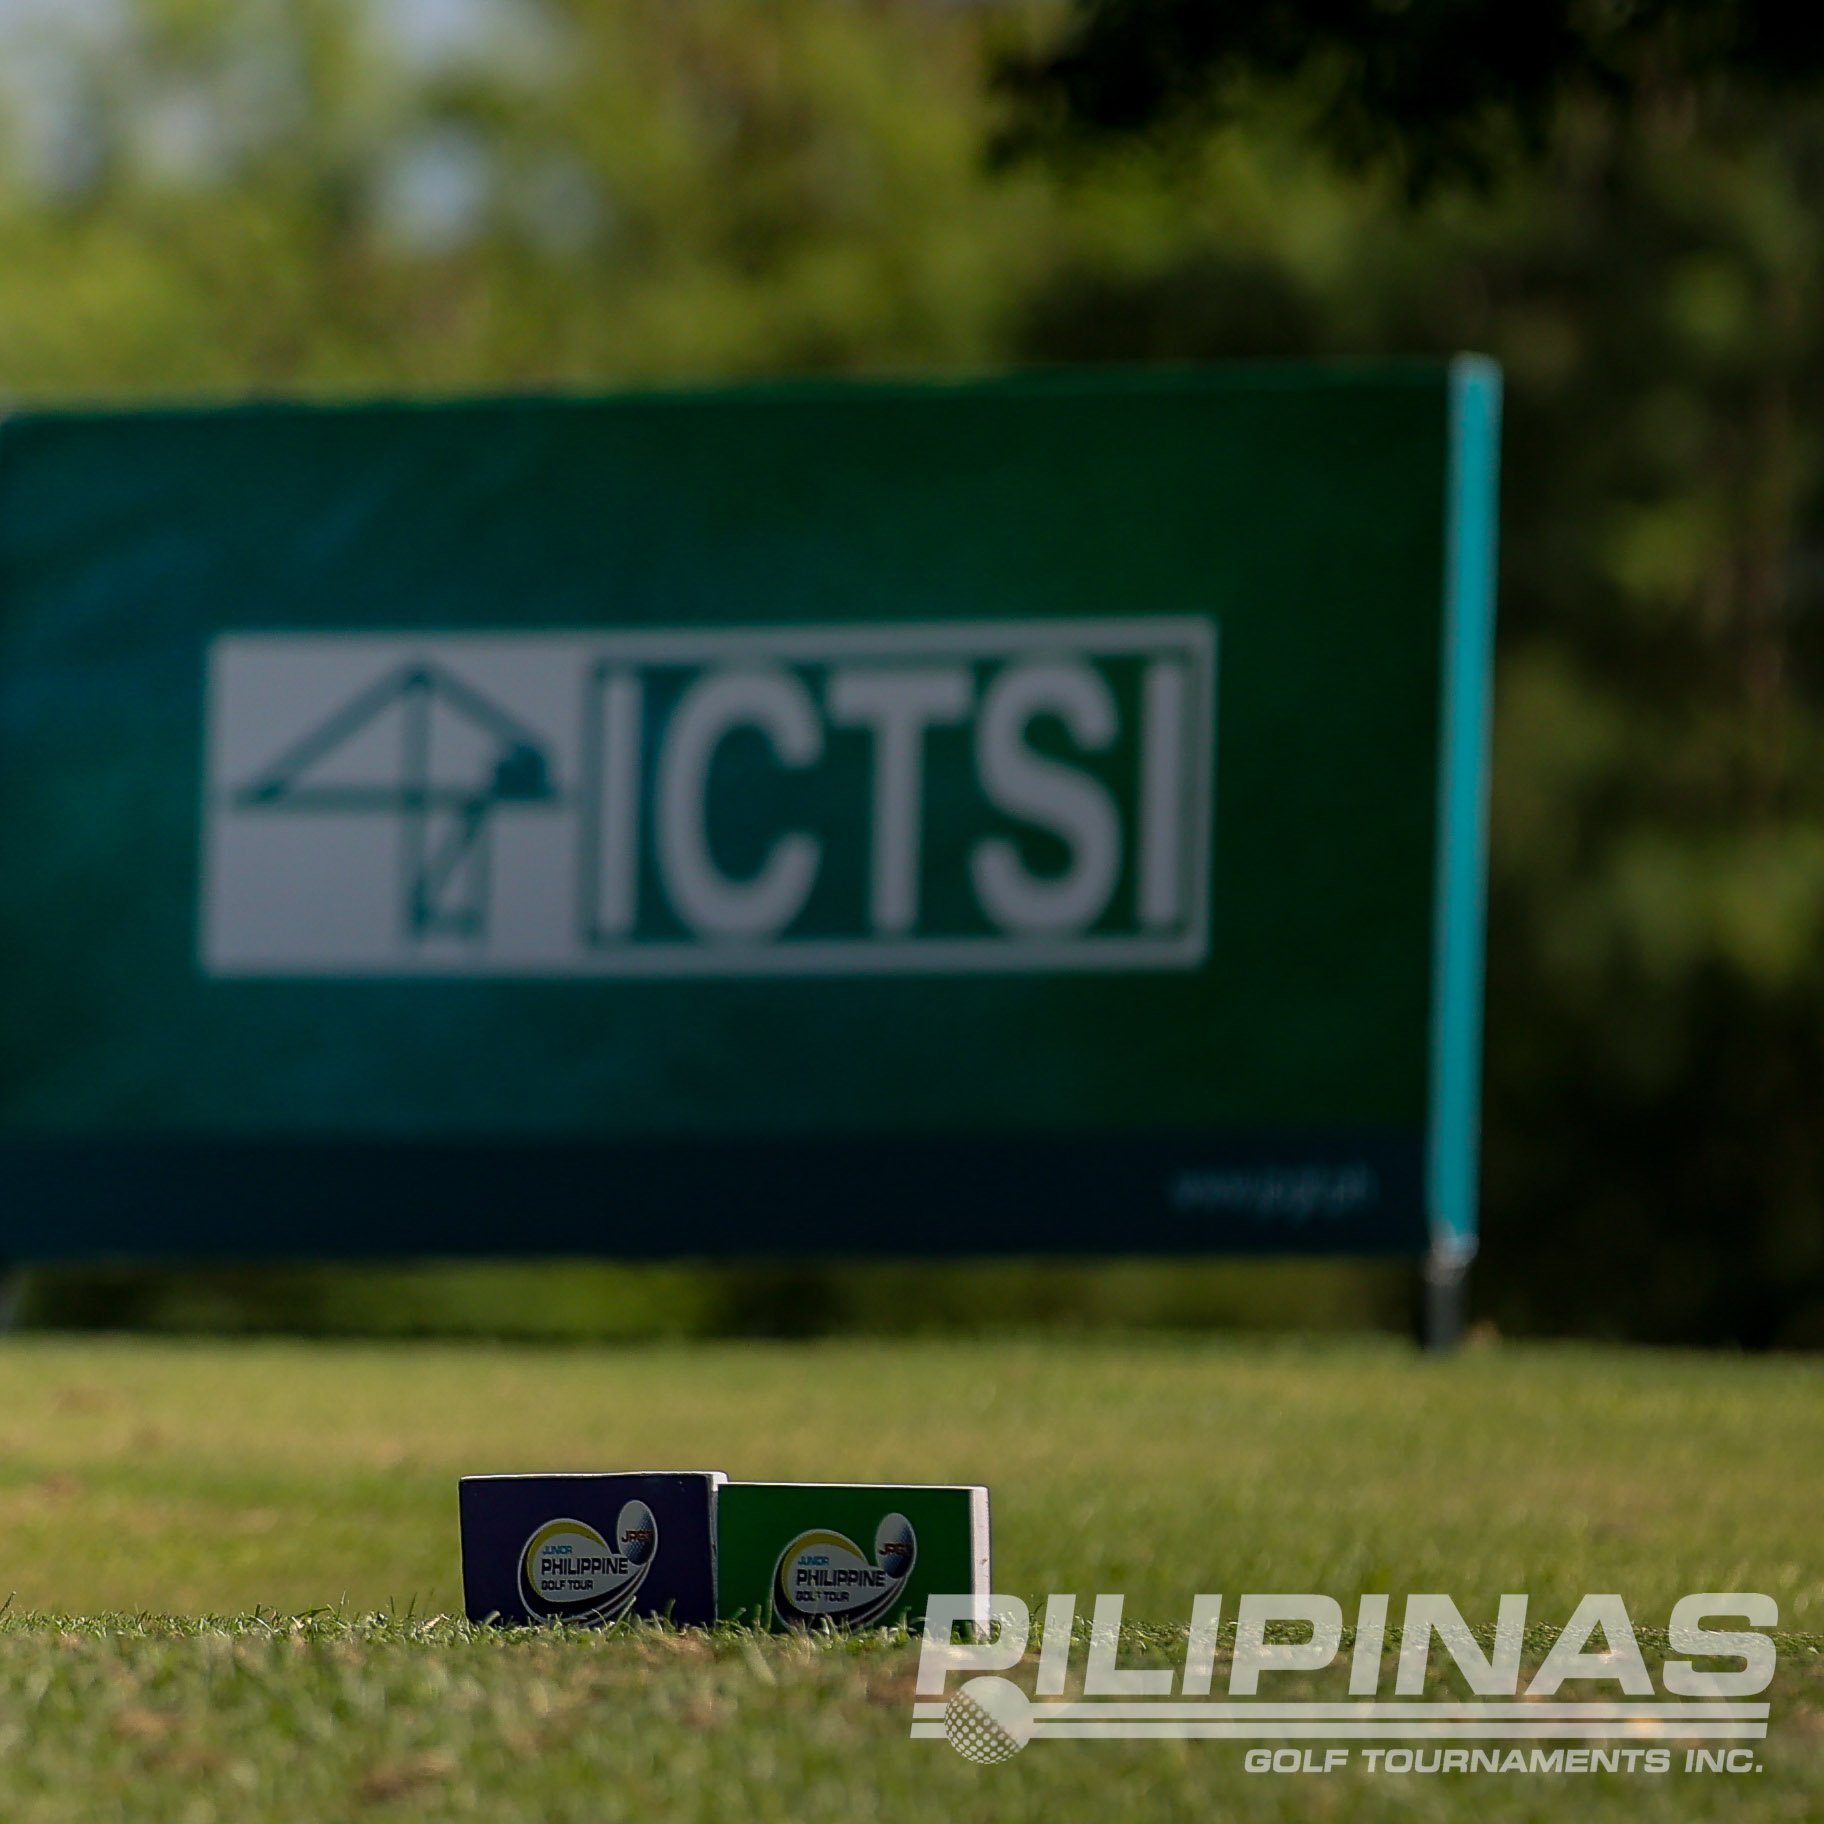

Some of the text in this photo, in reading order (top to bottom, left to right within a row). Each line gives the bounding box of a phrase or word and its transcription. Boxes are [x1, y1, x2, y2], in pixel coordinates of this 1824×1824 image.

[596, 650, 1188, 942] ICTSI
[541, 1557, 629, 1575] PHILIPPINE
[541, 1579, 594, 1591] GOLF TOUR
[796, 1568, 886, 1587] PHILIPPINE
[823, 1590, 850, 1602] TOUR
